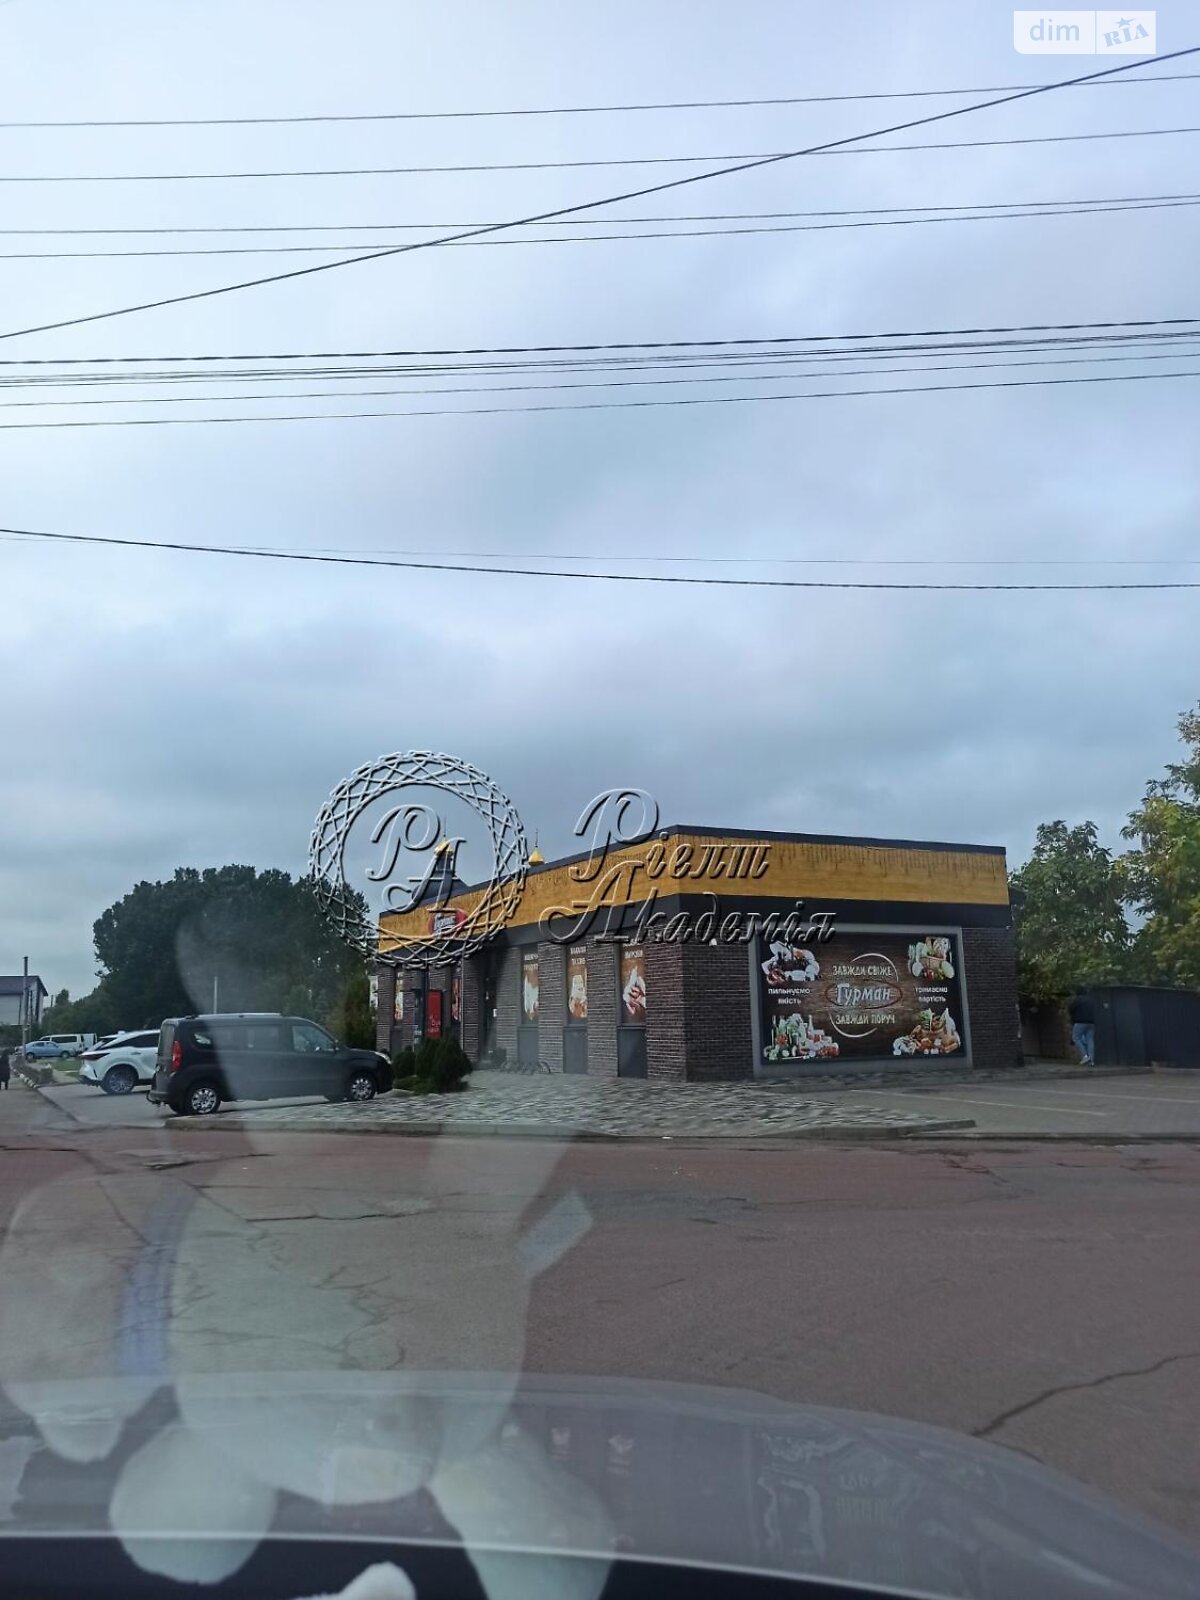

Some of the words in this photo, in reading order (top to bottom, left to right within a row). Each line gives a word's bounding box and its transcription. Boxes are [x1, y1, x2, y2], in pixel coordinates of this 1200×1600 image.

[832, 965, 866, 976] ЗАВЖДИ
[867, 965, 892, 976] СВІЖЕ
[837, 982, 891, 1006] Гурман
[835, 1013, 869, 1025] ЗАВЖДИ
[871, 1013, 896, 1024] ПОРУЧ
